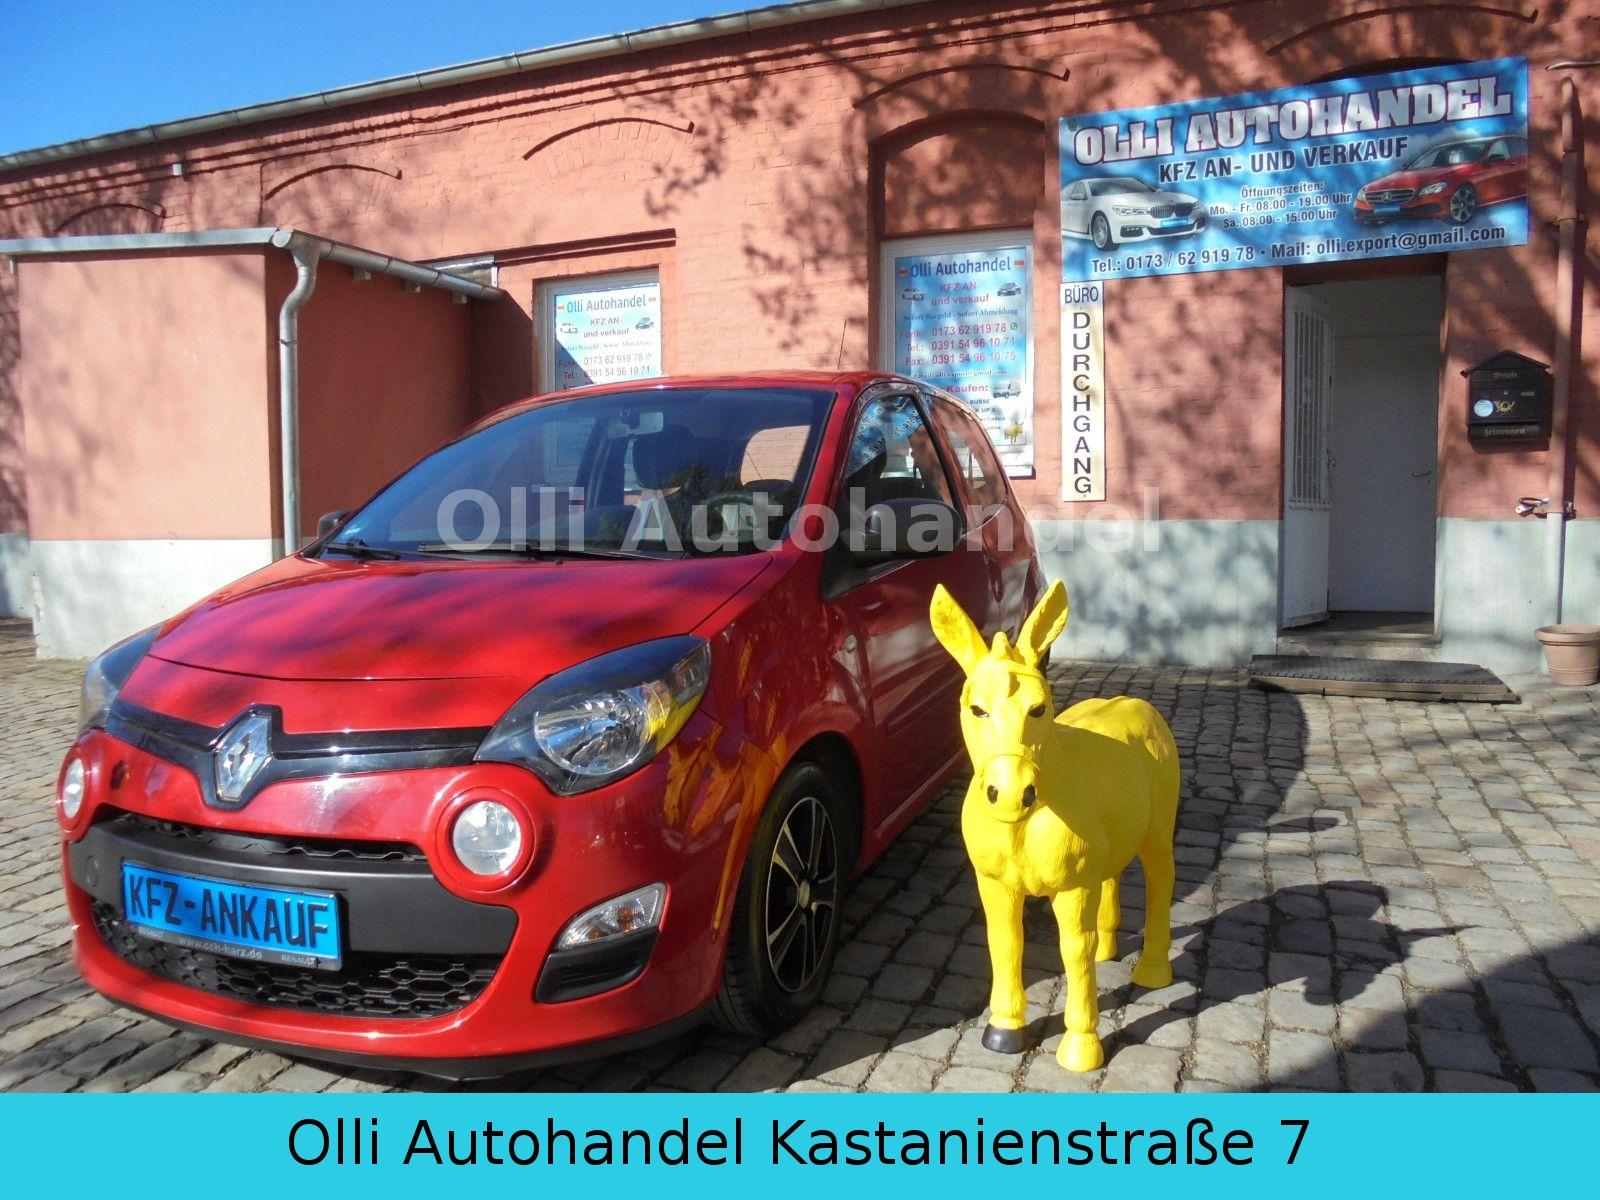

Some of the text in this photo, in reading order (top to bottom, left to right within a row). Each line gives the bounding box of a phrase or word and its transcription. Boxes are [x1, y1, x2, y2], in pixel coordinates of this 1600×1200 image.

[1074, 76, 1513, 165] OLLI AUTOHANDEL
[1159, 136, 1408, 183] KFZ AN- UND VERKAUF
[1241, 182, 1324, 199] Öffnungszeiten:
[1240, 203, 1252, 213] Fr.
[1256, 199, 1286, 211] 08.00
[1299, 194, 1329, 207] 19.00
[1333, 192, 1351, 204] Uhr
[1223, 218, 1238, 229] Sa.
[1242, 215, 1273, 226] 08.00
[1285, 210, 1314, 222] 15.00
[1318, 209, 1337, 220] Uhr
[1092, 258, 1121, 274] Tel.:
[1126, 254, 1163, 270] 0173
[1178, 251, 1196, 266] 62
[1202, 249, 1230, 264] 919
[1236, 246, 1254, 261] 78
[1271, 241, 1311, 259] Mail:
[1316, 225, 1506, 255] olli.export@gmail.com
[910, 257, 1011, 277] Olli Autohandel
[566, 294, 646, 313] Olli Autohandel
[931, 296, 950, 305] und
[1064, 285, 1098, 304] BÜRO
[931, 326, 956, 337] 0173
[959, 325, 971, 335] 62
[973, 324, 991, 334] 919
[995, 323, 1007, 333] 78
[931, 341, 955, 351] 0391
[946, 383, 988, 393] Kaufen:
[1073, 312, 1091, 494] DURCHGANG
[130, 873, 329, 948] KFZ-ANKAUF
